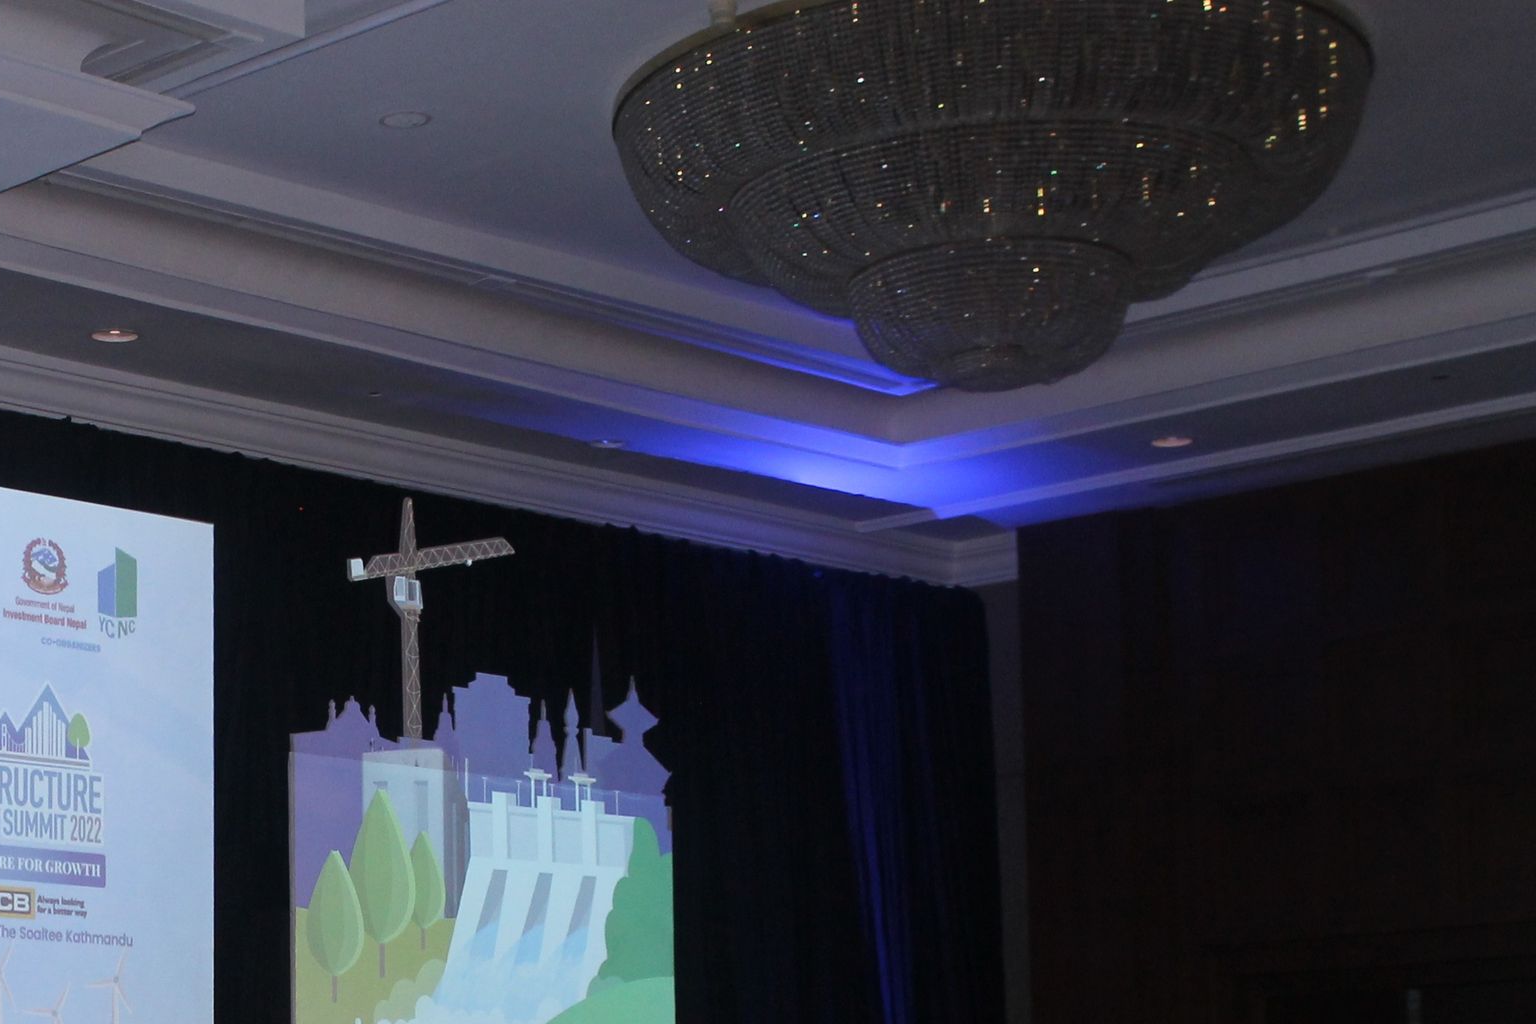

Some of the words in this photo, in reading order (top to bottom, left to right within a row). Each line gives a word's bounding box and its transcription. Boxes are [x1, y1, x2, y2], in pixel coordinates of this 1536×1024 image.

[15, 596, 50, 609] Government
[51, 601, 57, 612] of
[58, 602, 75, 615] Nepal
[2, 608, 43, 623] Investment
[44, 614, 65, 627] Board
[66, 617, 87, 631] Nepal
[3, 809, 67, 841] SUMMIT
[70, 815, 102, 843] 2022
[17, 857, 43, 872] FOR
[45, 859, 101, 877] GROWTH
[37, 894, 60, 905] Always
[37, 904, 46, 913] for
[74, 910, 88, 919] way
[19, 926, 63, 942] Soaltee
[66, 929, 134, 947] Kathmandu
